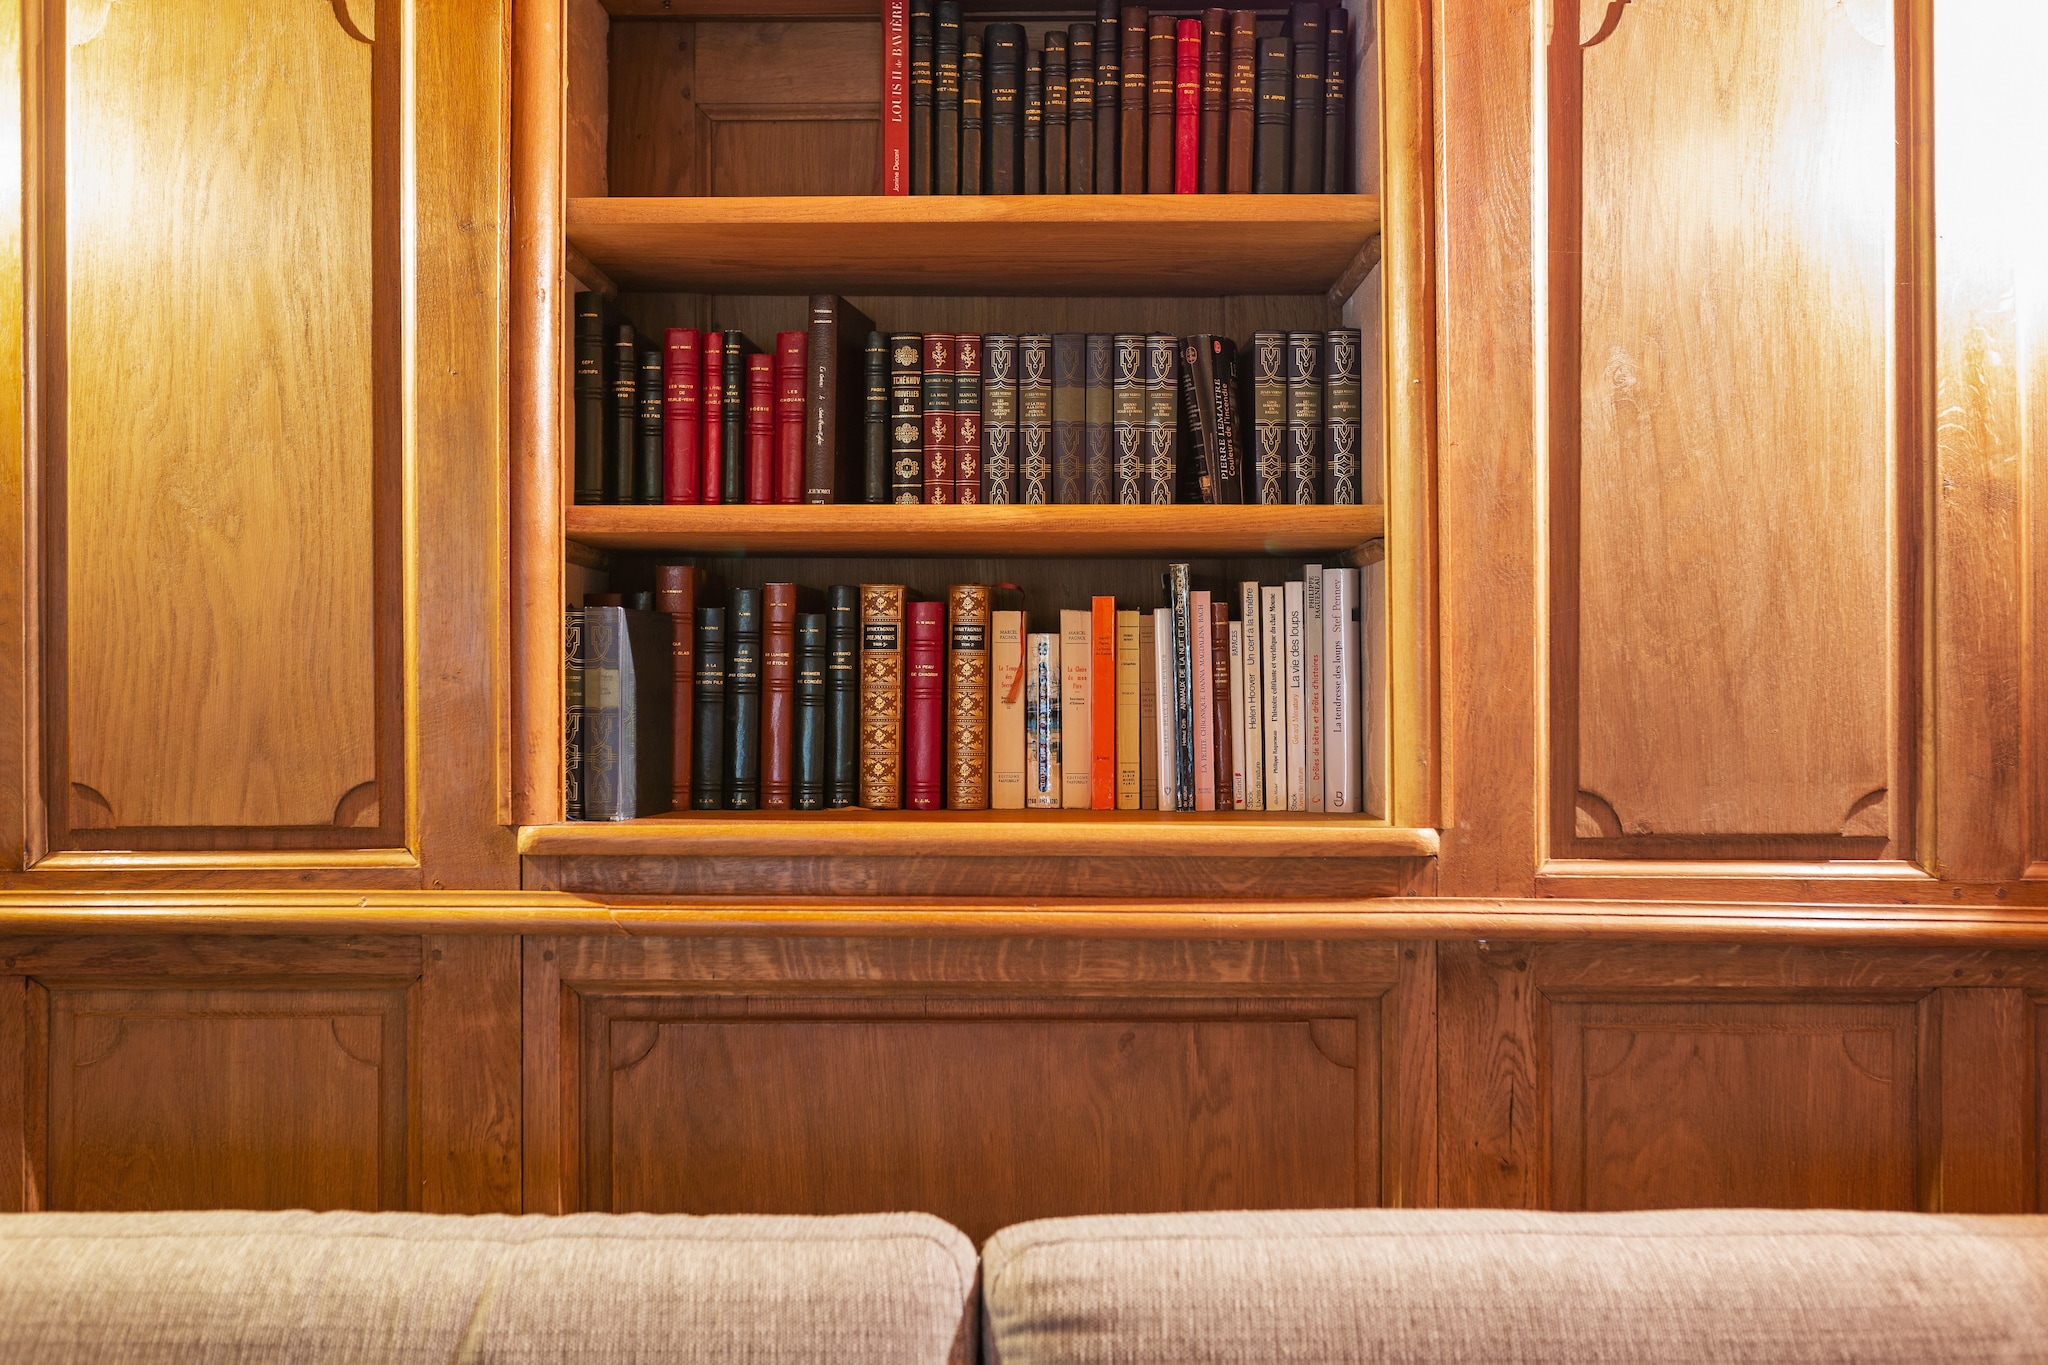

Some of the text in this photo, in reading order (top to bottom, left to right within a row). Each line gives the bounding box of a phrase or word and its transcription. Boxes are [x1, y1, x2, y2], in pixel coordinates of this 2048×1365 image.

[890, 2, 902, 123] LOUIS II de BAVIÈRE
[893, 376, 921, 385] TCHÉKHOV
[899, 404, 915, 412] RÉCITS
[1214, 378, 1229, 480] PIERRE LEMAITRE
[1223, 383, 1236, 477] Couleurs de l'incendie
[1246, 588, 1254, 617] fenêtre
[1332, 580, 1343, 632] Stef Penney
[1178, 616, 1184, 626] DU
[1178, 630, 1184, 638] ET
[1270, 626, 1276, 635] du
[1290, 610, 1300, 688] La vie des loups
[1178, 656, 1185, 666] LA
[1247, 654, 1255, 666] Un
[1006, 665, 1019, 673] Temp
[1179, 668, 1185, 678] DE
[1332, 640, 1343, 732] La tendresse des loups
[1314, 716, 1319, 724] et
[1201, 764, 1207, 773] LA
[1256, 781, 1261, 789] de
